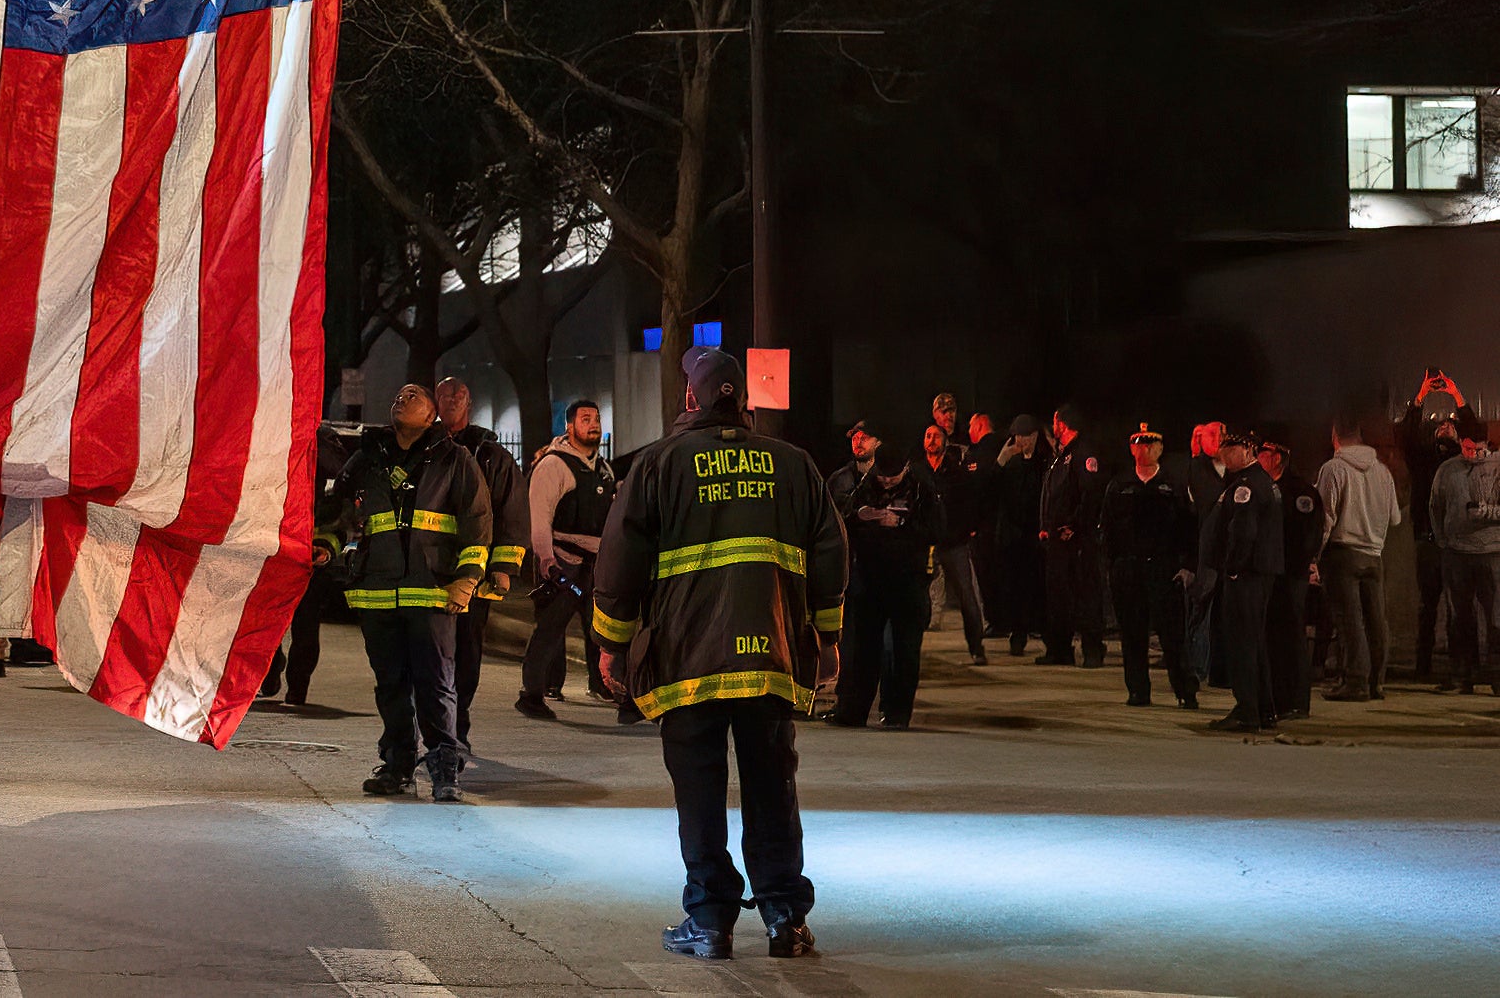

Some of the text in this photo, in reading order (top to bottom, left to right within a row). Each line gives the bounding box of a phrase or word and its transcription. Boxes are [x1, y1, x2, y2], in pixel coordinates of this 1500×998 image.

[693, 448, 776, 477] CHICAGO
[698, 480, 776, 504] FIRE DEPT
[735, 635, 770, 655] DIAZ
